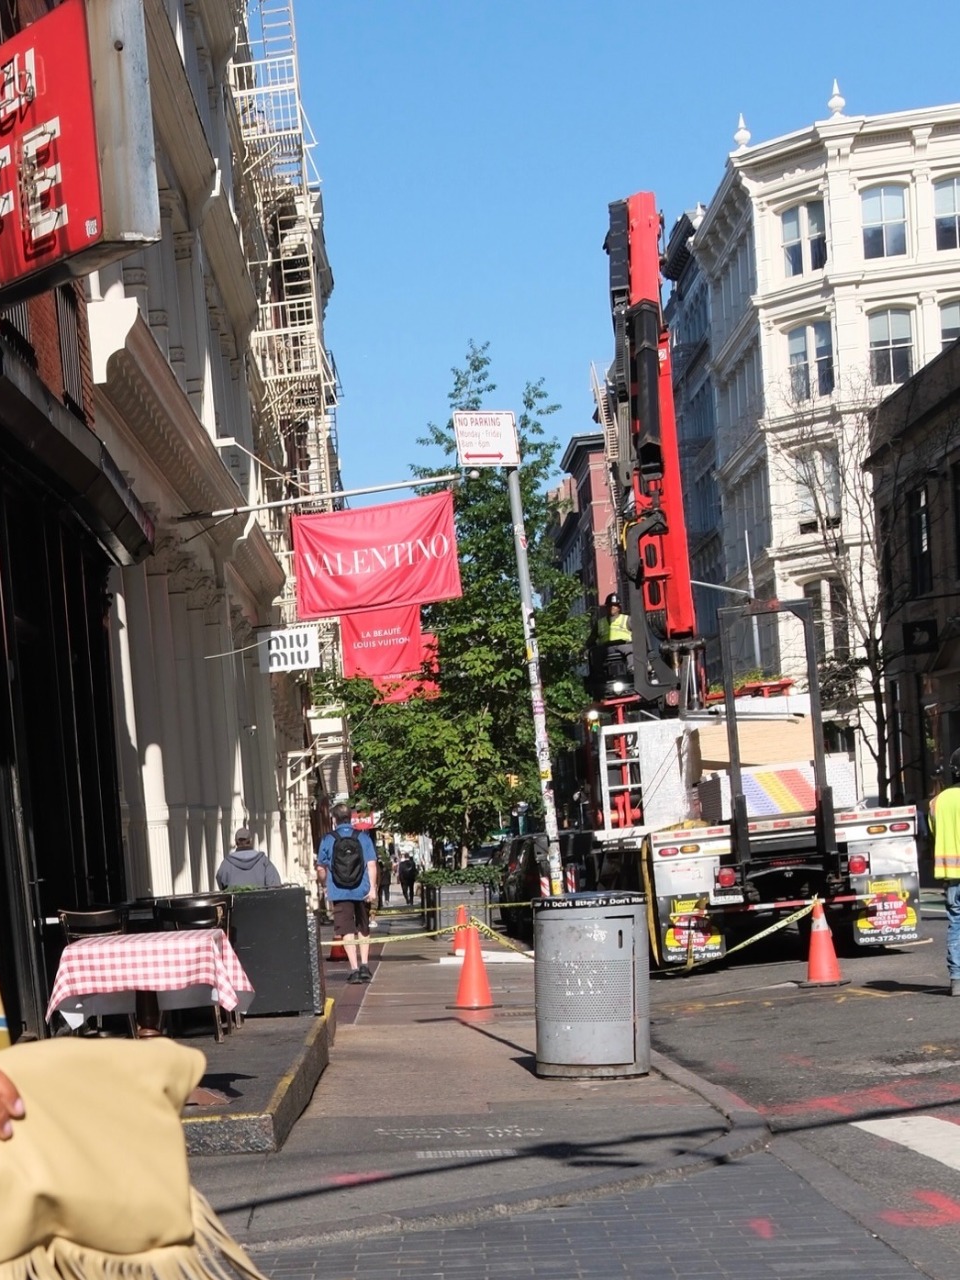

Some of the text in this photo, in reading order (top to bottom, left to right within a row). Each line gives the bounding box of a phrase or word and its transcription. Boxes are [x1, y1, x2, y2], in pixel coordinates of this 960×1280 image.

[458, 417, 501, 426] NO PARKING
[460, 430, 480, 439] Monday
[485, 430, 501, 439] Friday
[303, 534, 449, 578] VALENTINO
[353, 636, 410, 649] LOUIS VUITTON
[883, 901, 904, 910] STOP
